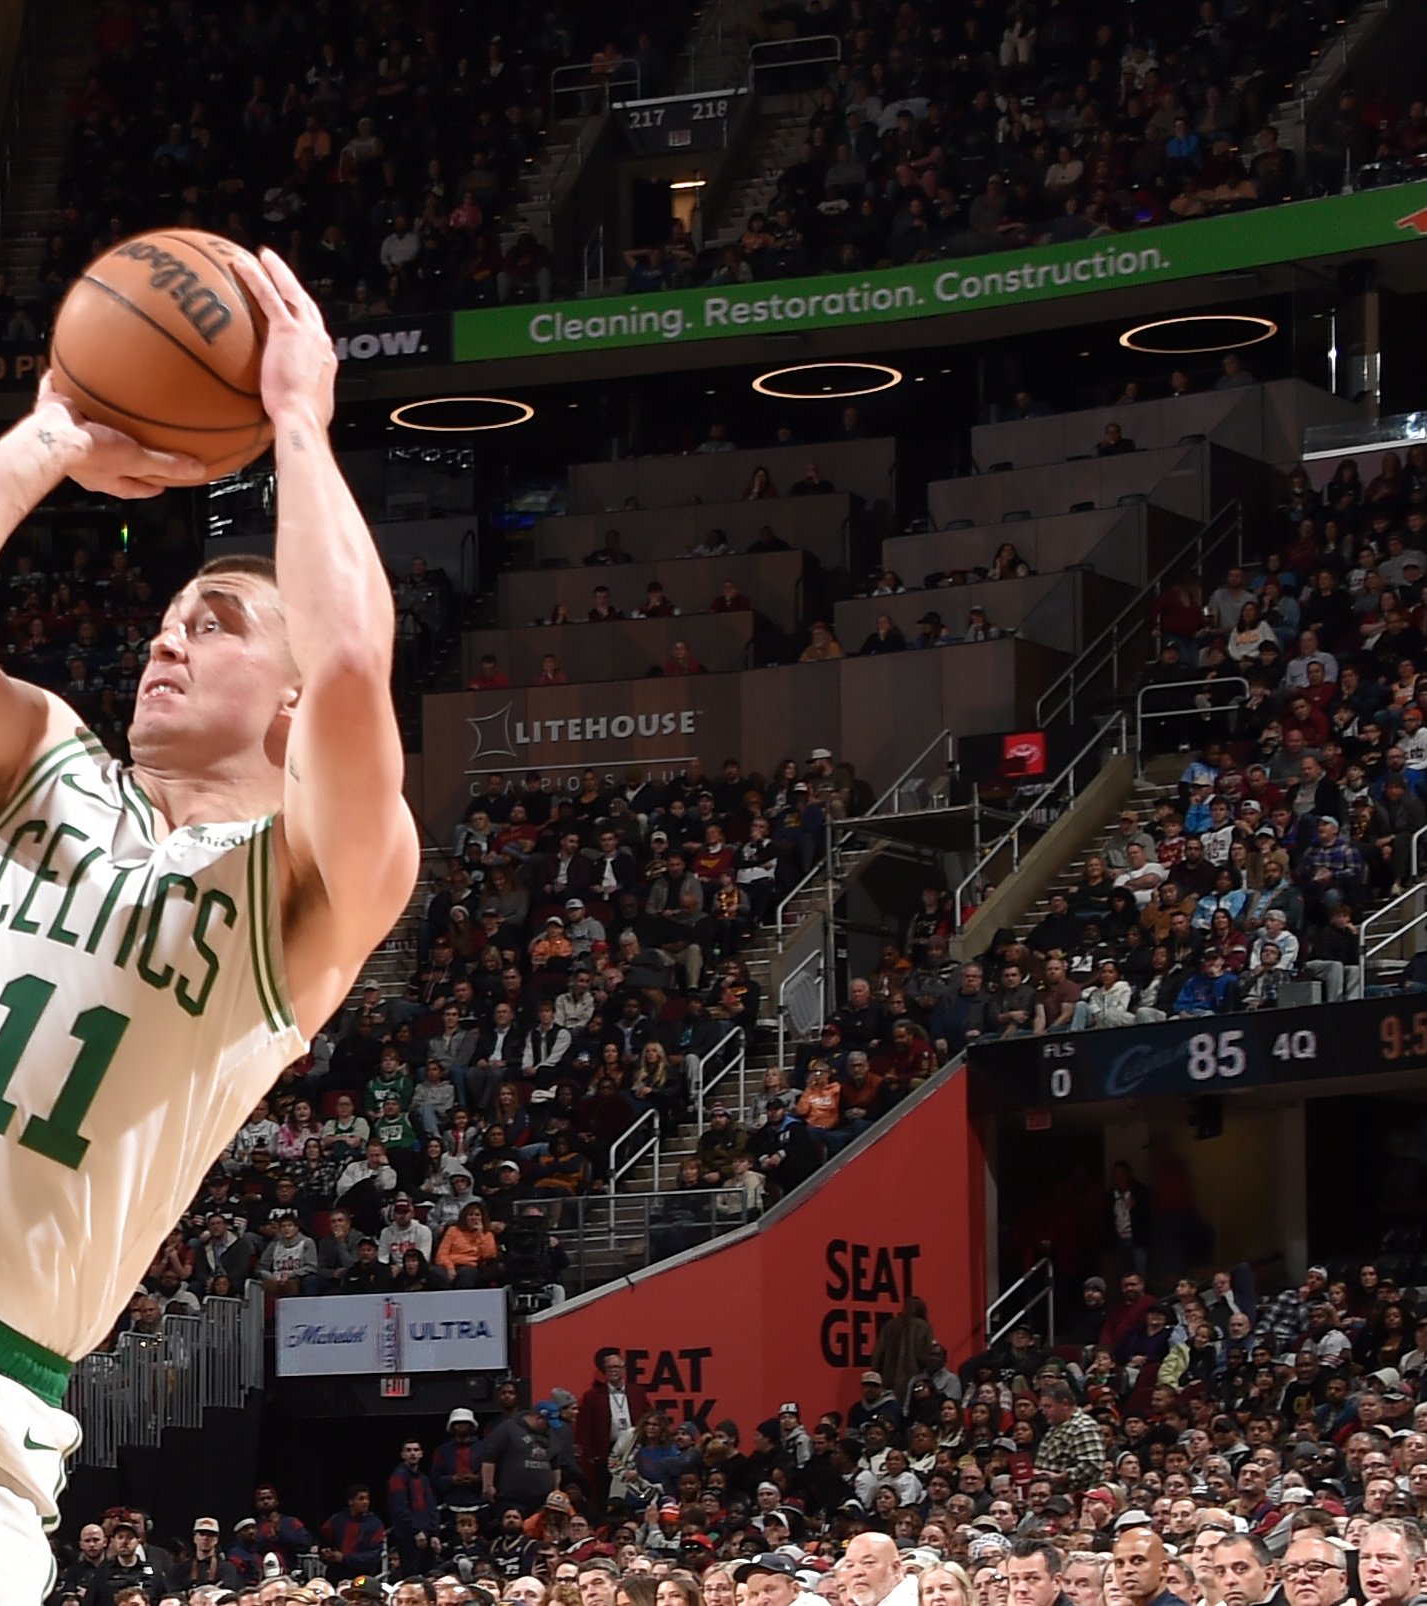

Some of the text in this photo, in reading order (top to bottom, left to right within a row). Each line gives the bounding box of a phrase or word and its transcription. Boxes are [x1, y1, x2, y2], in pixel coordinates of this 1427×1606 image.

[629, 109, 665, 129] 217
[692, 100, 728, 120] 218
[528, 242, 1170, 346] Cleaning. Restoration. Construction.
[515, 710, 695, 745] LITEHOUSE
[470, 774, 615, 798] CAPIOS
[1043, 1042, 1076, 1059] FLS
[1187, 1030, 1247, 1081] 85
[1271, 1030, 1318, 1061] 4Q
[1050, 1068, 1072, 1098] 0
[826, 1239, 921, 1303] SEAT
[409, 1320, 493, 1341] ULTRA
[821, 1308, 894, 1368] GE
